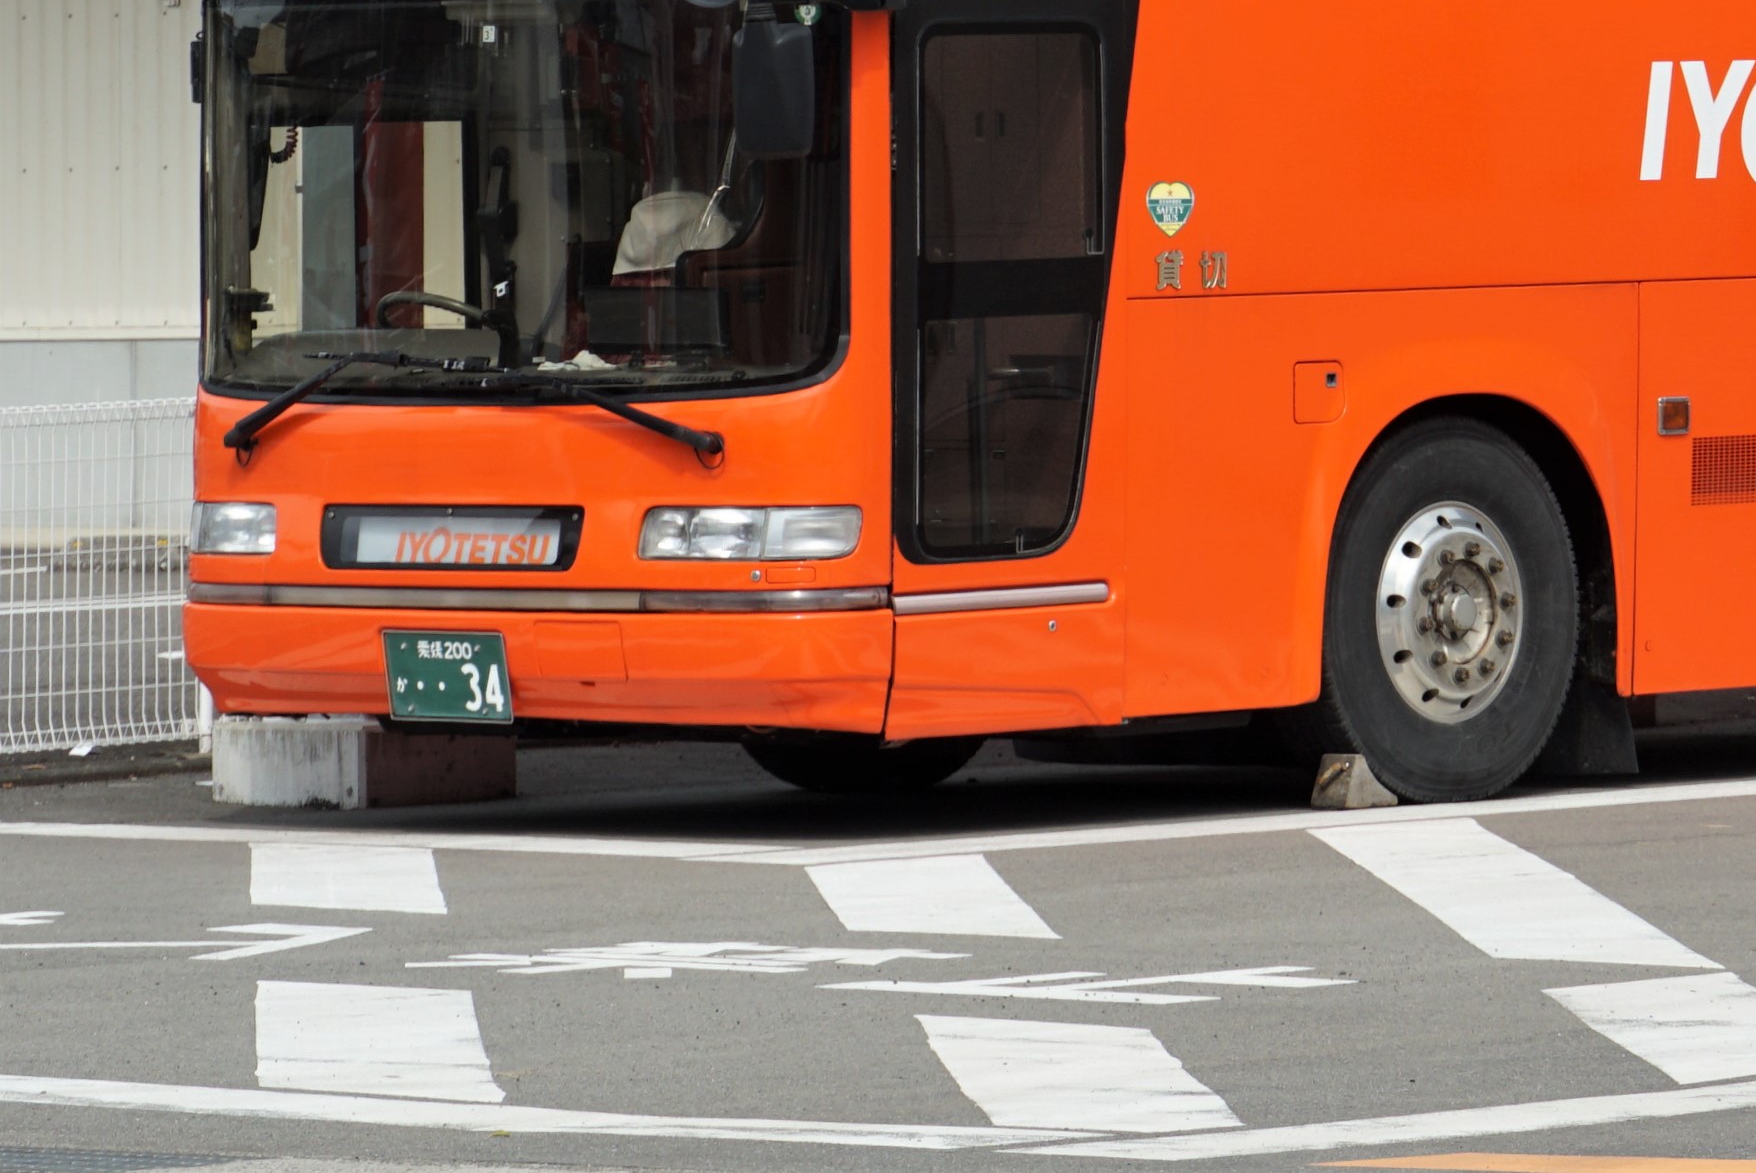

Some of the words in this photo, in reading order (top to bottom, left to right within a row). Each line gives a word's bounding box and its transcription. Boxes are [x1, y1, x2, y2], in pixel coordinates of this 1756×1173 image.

[1156, 206, 1184, 215] SAFETY
[1163, 214, 1179, 223] BUS
[1155, 249, 1227, 290] 貸切
[395, 527, 550, 565] IYOTETSU
